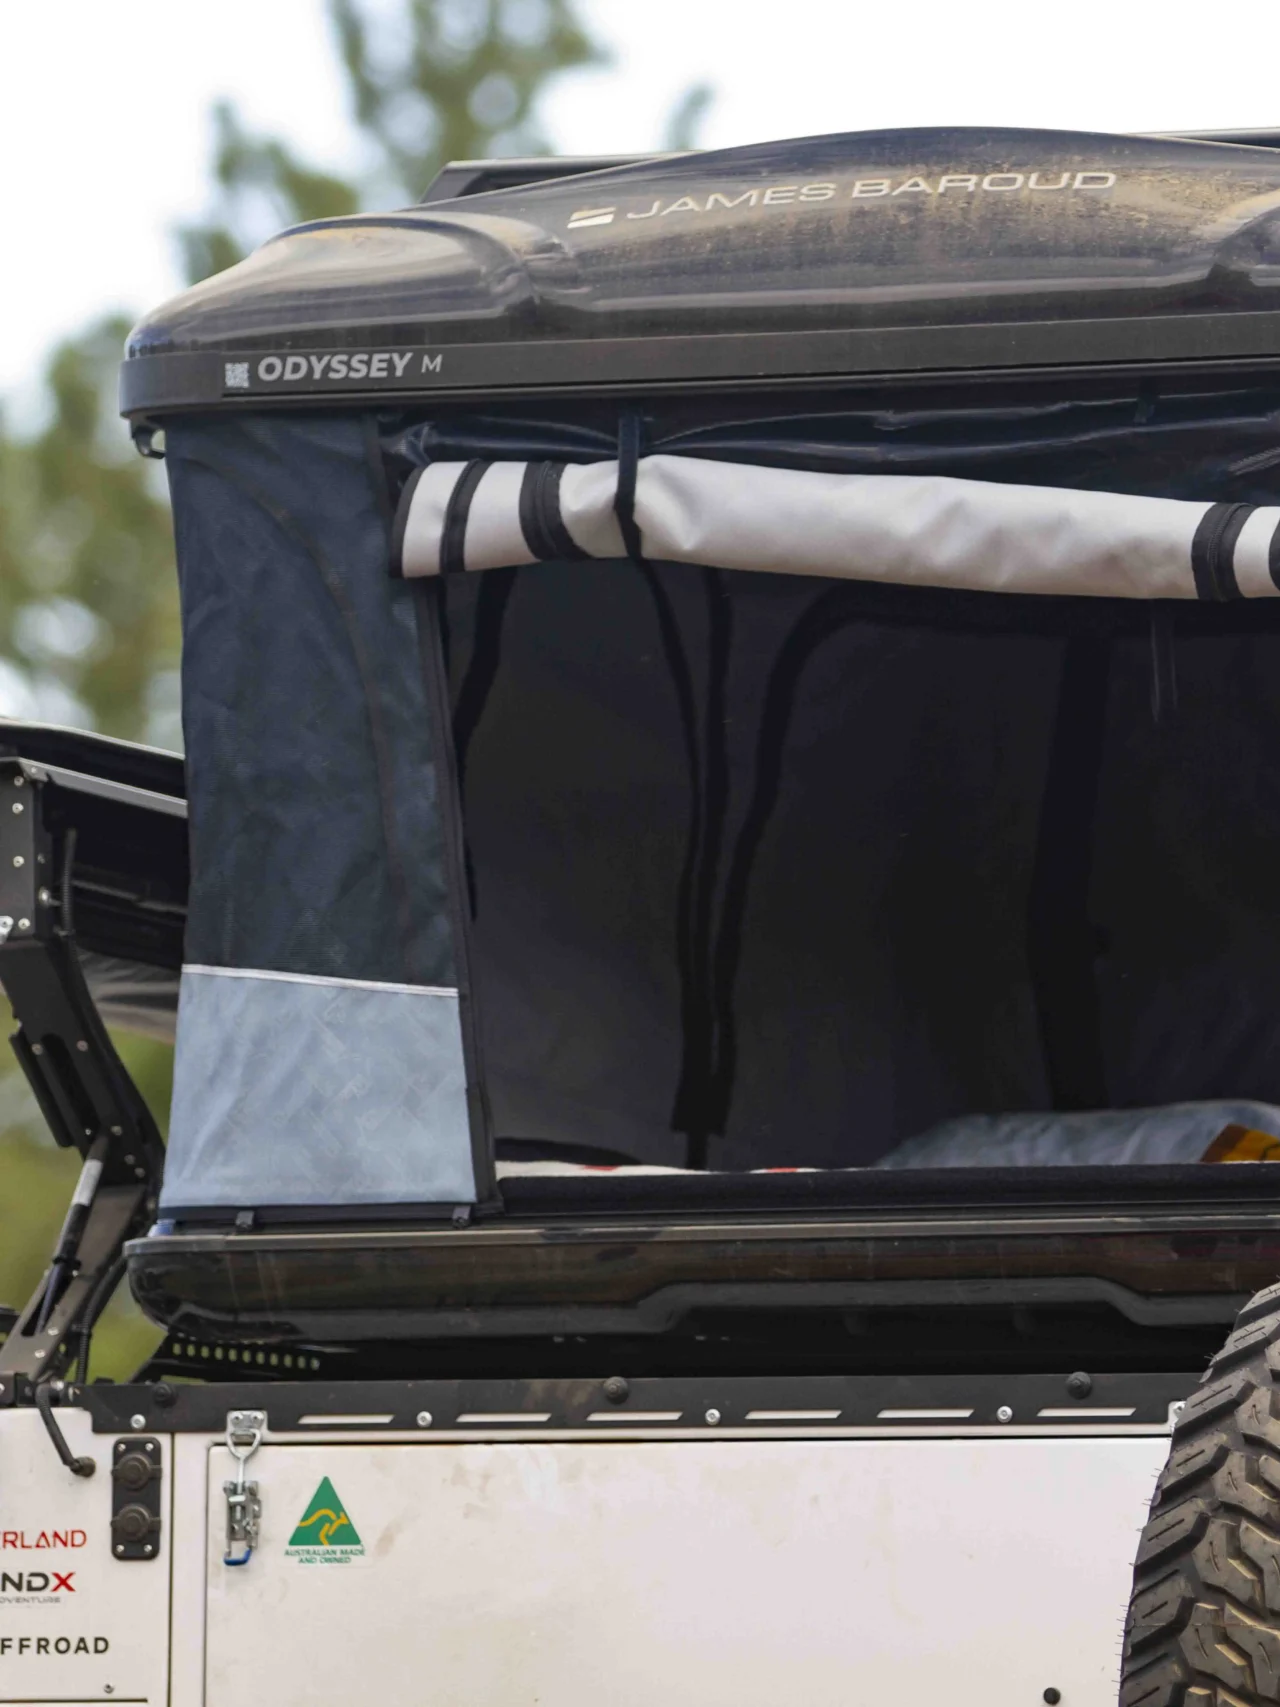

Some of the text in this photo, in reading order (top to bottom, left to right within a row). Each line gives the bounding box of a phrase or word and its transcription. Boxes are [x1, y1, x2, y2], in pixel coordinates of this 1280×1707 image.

[625, 171, 1117, 220] JAMES BAROUD
[257, 352, 443, 381] ODYSSEY M
[0, 1529, 87, 1549] RLAND
[284, 1548, 365, 1557] AUSTRALIAN MADE
[298, 1556, 351, 1564] AND OWNED
[1, 1636, 109, 1656] FFROAD
